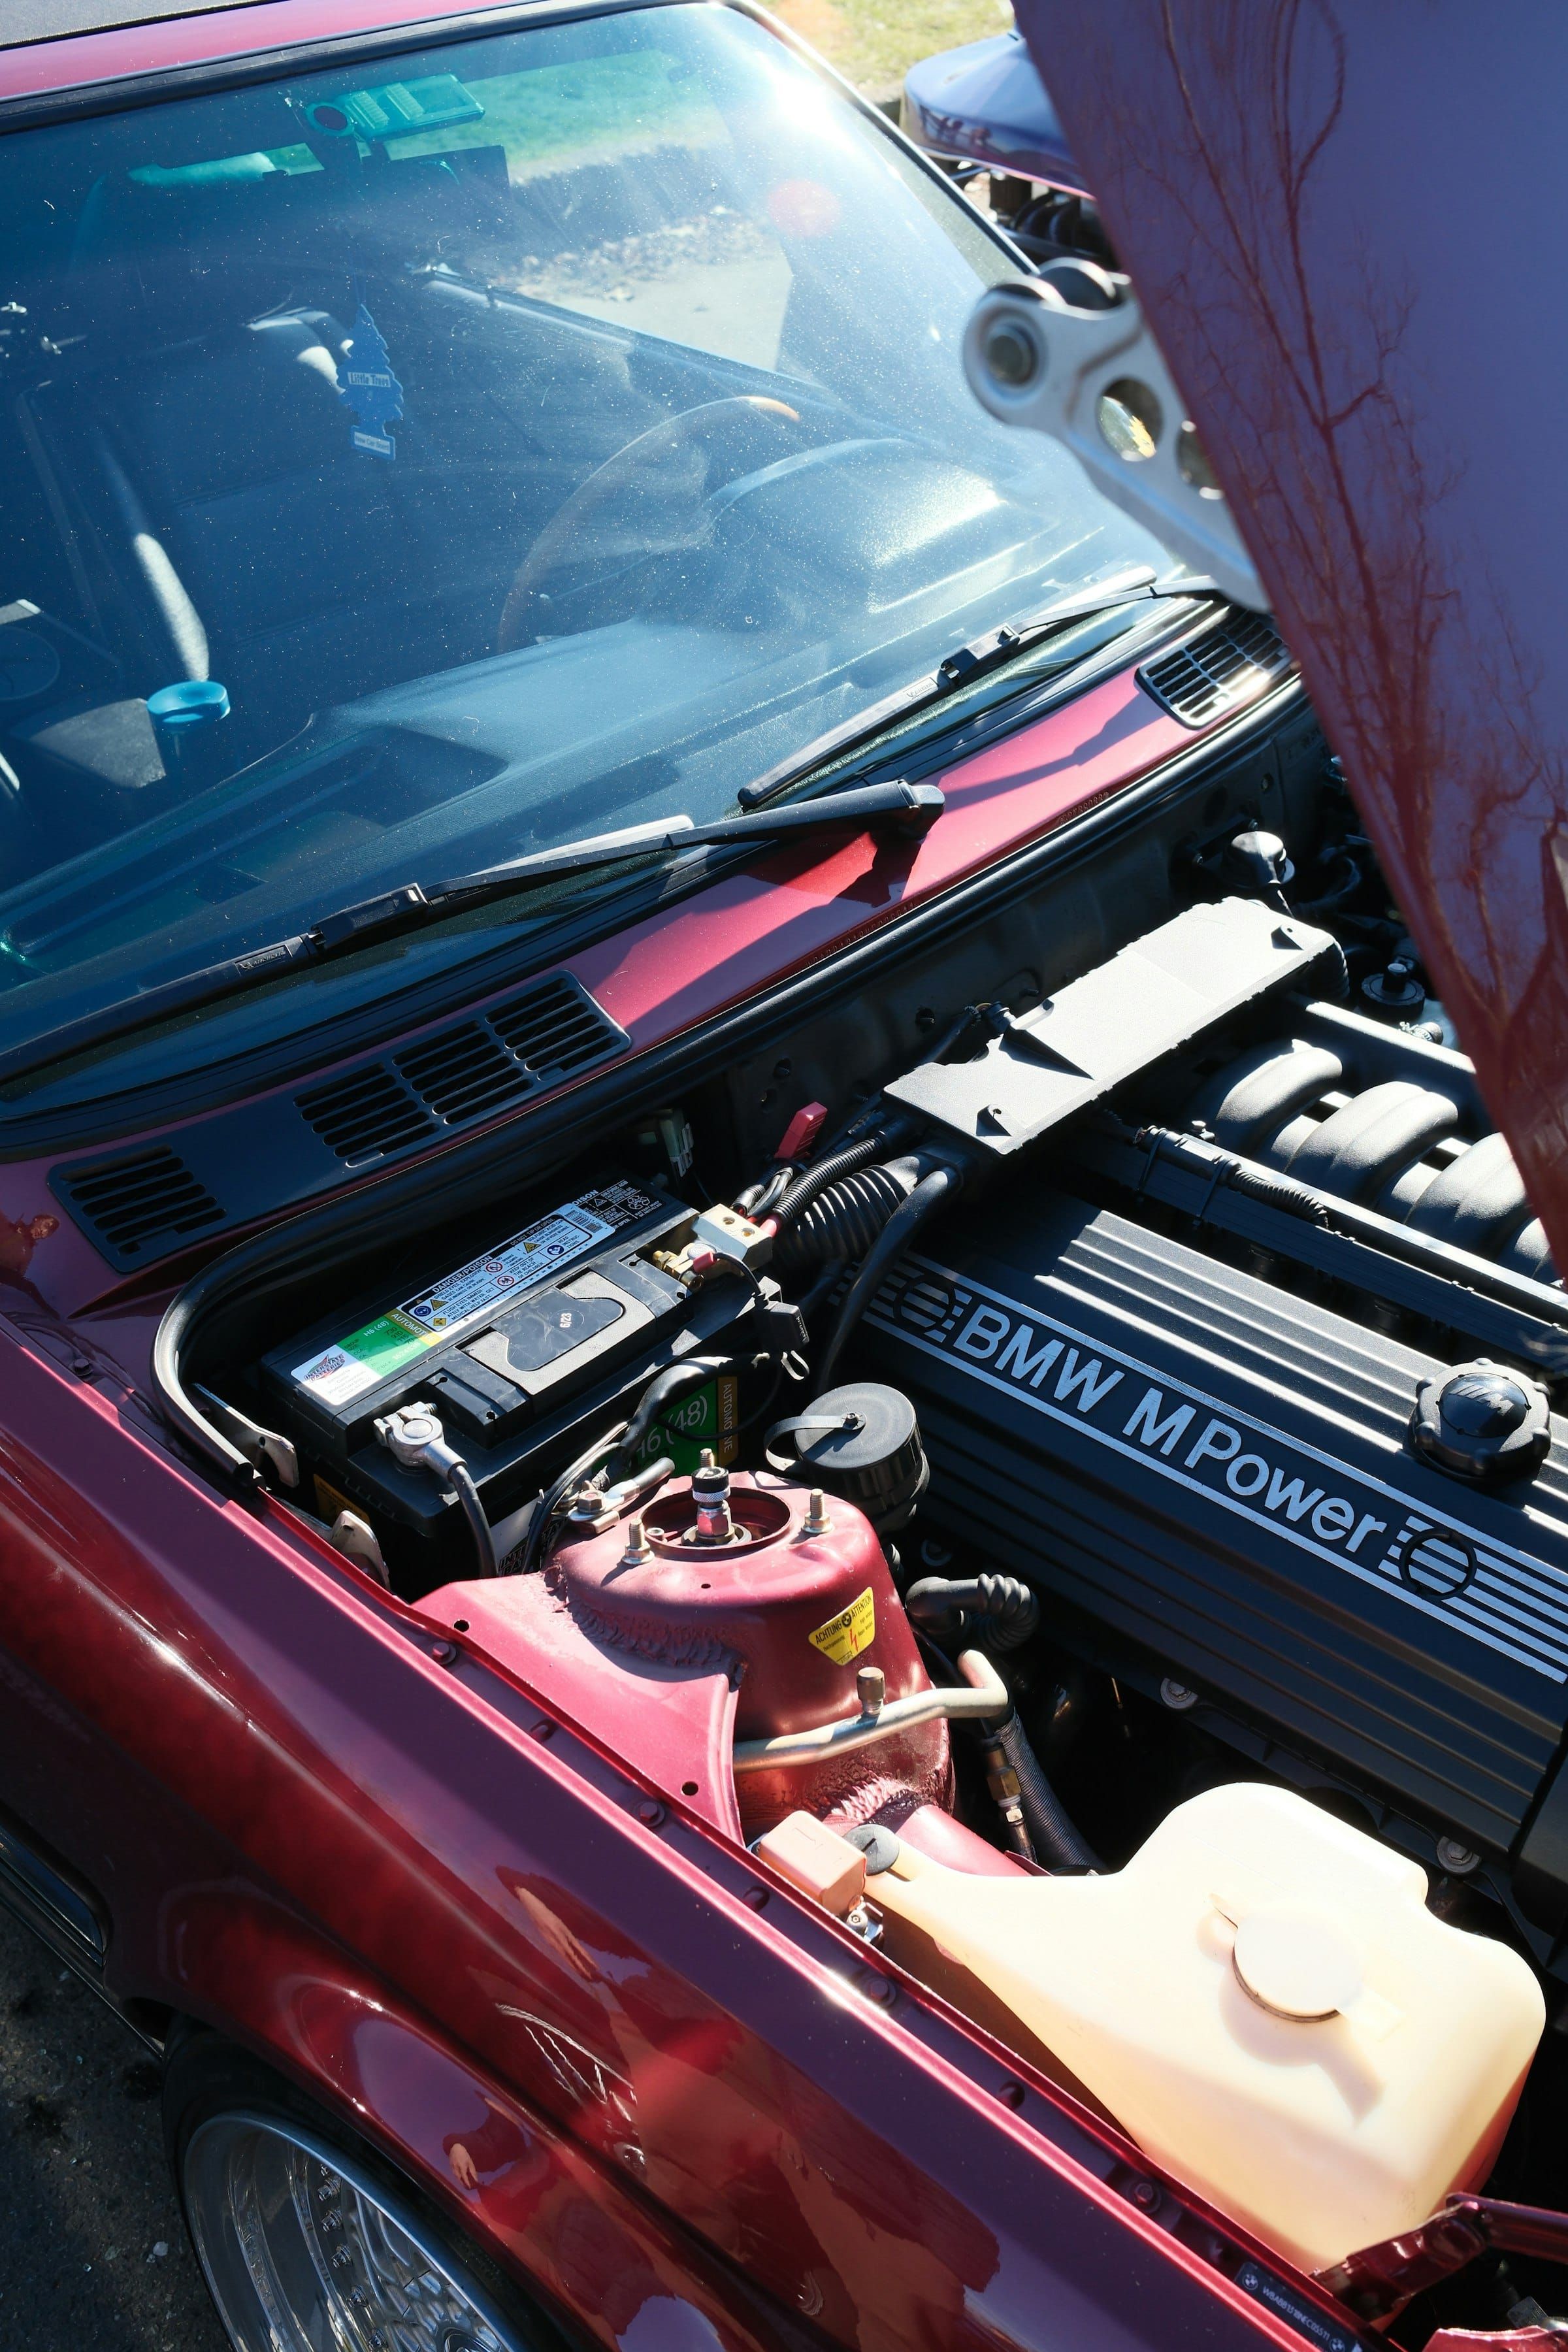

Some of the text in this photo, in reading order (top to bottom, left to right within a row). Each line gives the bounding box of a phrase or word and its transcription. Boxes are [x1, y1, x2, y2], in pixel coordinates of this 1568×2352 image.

[432, 1255, 493, 1293] DANGER/POISON
[374, 1320, 389, 1330] (48)
[447, 1309, 460, 1317] ATELY
[451, 1308, 470, 1320] MEDICAL
[560, 1313, 572, 1328] 6/23
[391, 1312, 437, 1346] AUTOMOTVE
[391, 1330, 403, 1339] 910
[303, 1353, 345, 1380] INTERSTATE
[310, 1358, 346, 1382] BATTERIES
[953, 1302, 1125, 1413] BMW
[723, 1383, 733, 1454] AUTOMOVE
[851, 1593, 873, 1620] ATTENTION
[815, 1620, 843, 1645] ACHTUNG
